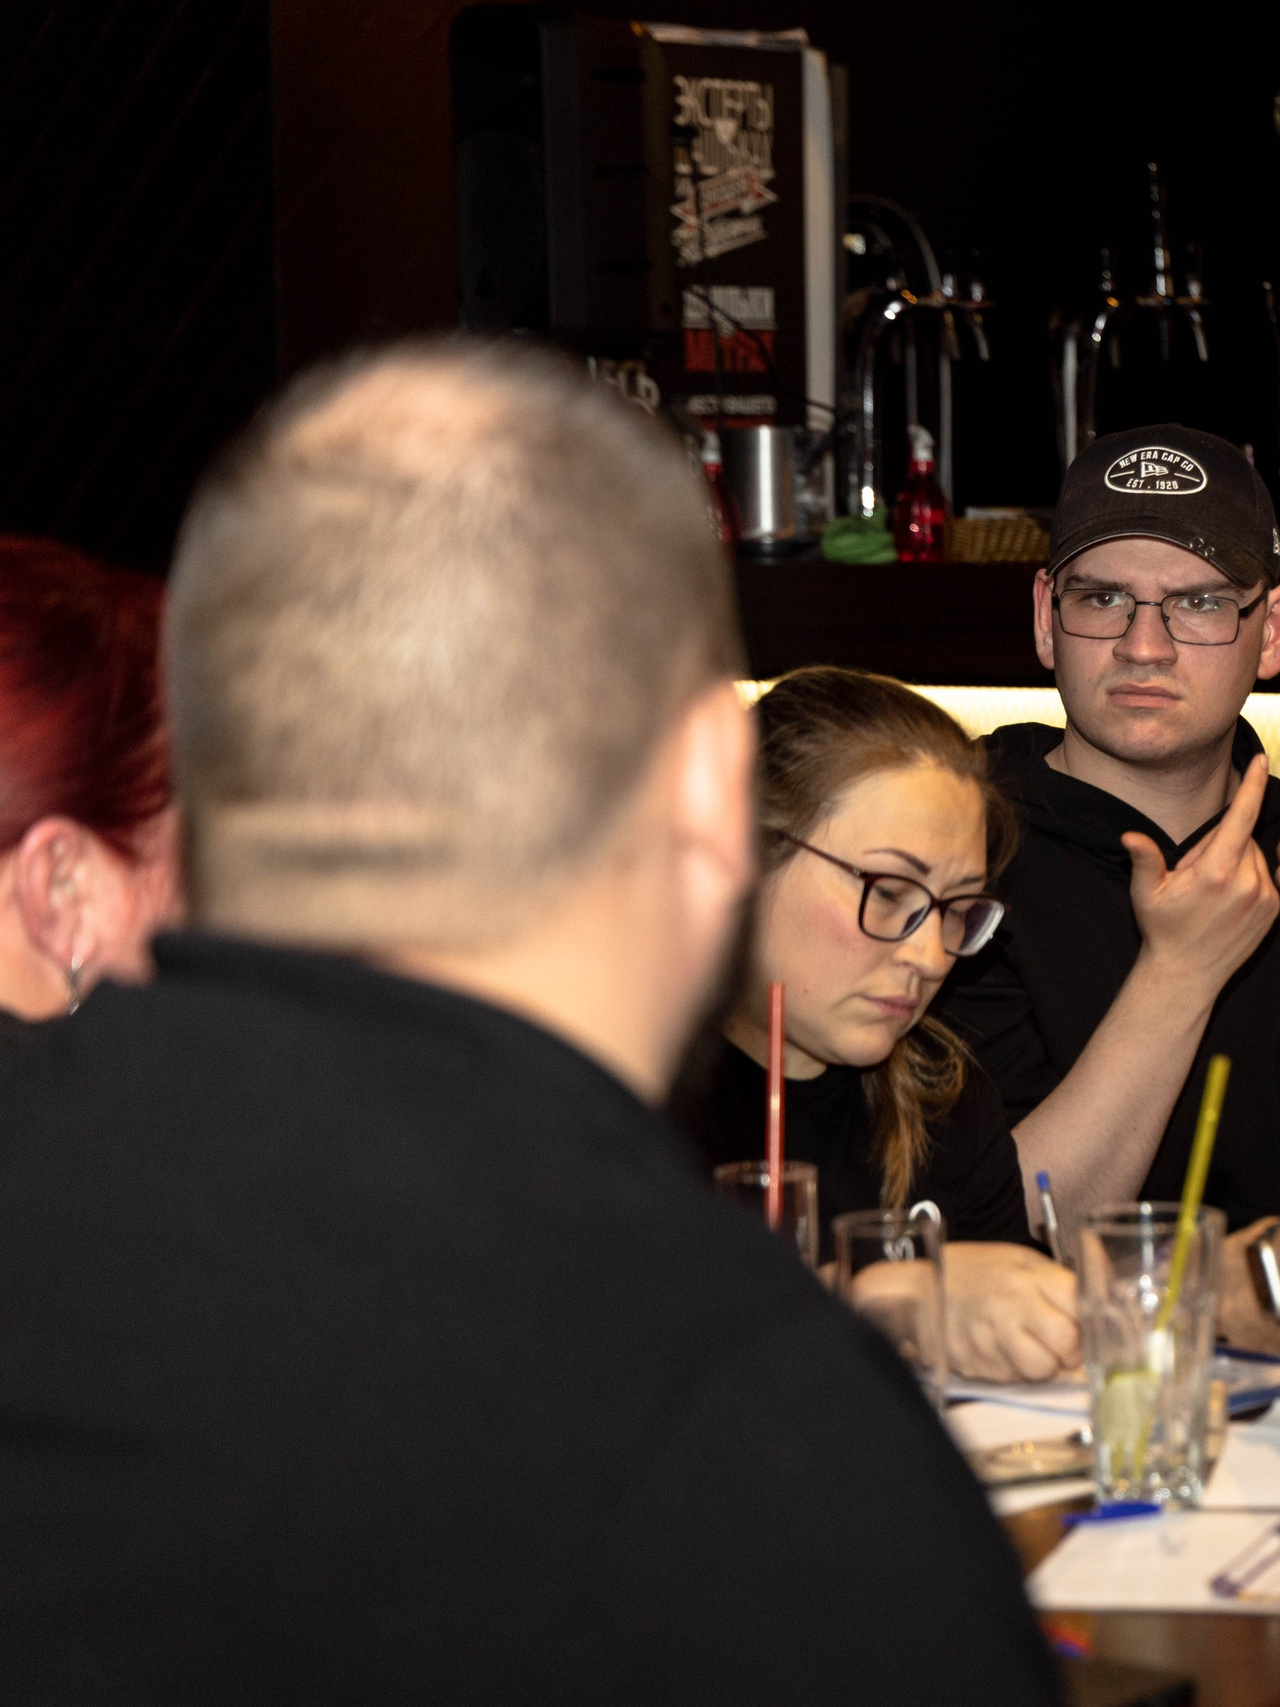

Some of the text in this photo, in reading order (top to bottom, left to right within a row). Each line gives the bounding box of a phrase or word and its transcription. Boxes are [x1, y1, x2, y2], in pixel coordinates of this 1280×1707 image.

[1118, 450, 1195, 472] NEW ERA CAP CO
[1155, 480, 1179, 490] 1920
